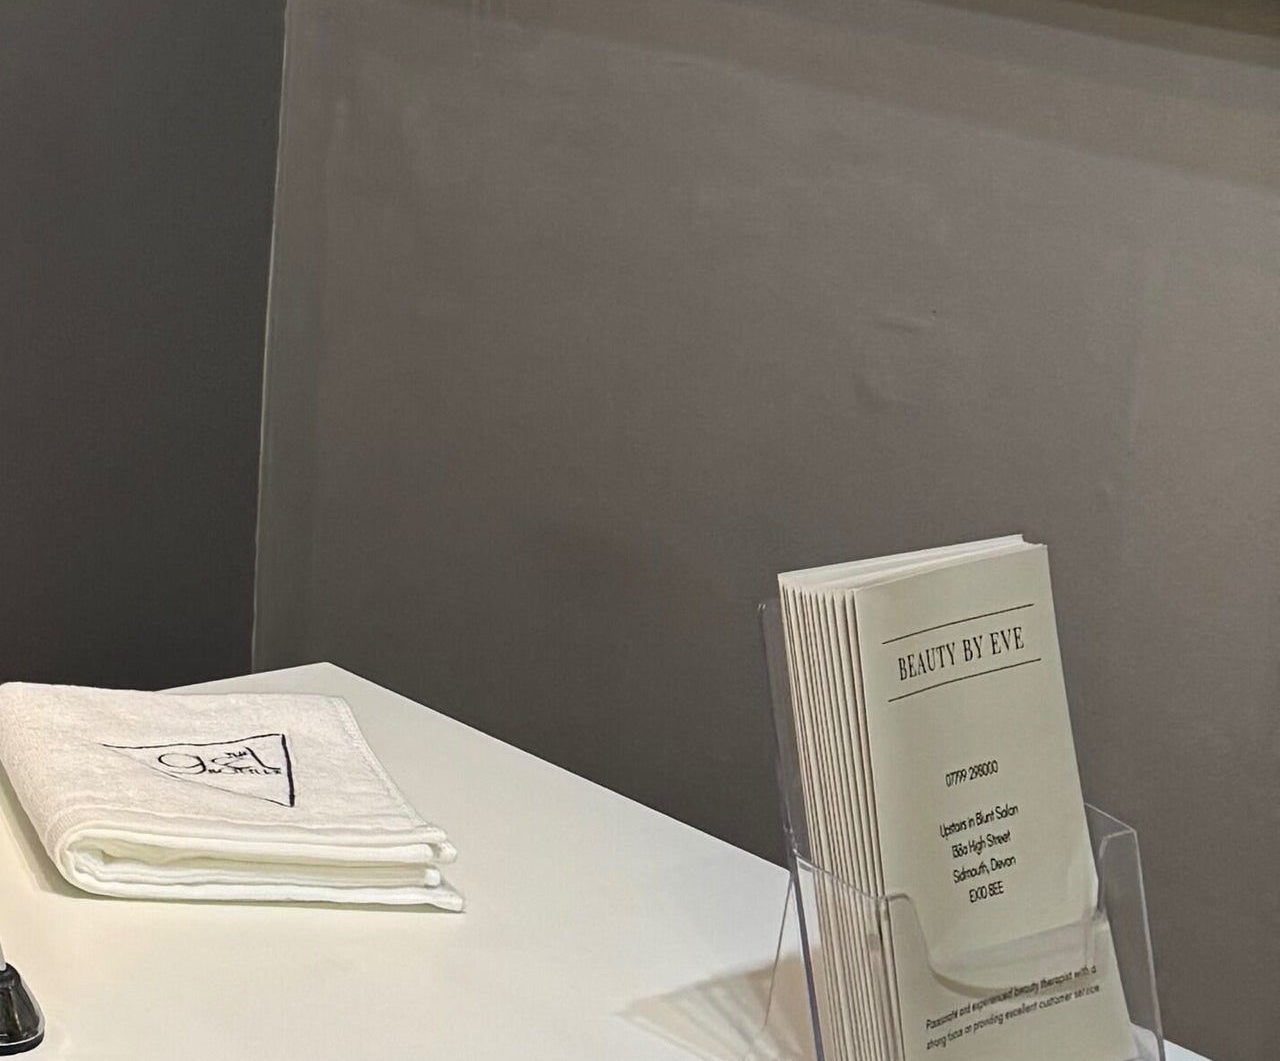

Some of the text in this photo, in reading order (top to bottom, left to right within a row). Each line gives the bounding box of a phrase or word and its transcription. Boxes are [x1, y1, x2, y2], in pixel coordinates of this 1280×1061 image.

[898, 626, 1025, 681] BEAUTY BY EVE
[157, 746, 282, 775] gel
[939, 803, 1019, 841] Upstairs in Blunt Salon
[968, 835, 987, 856] High
[986, 829, 1011, 848] Street
[990, 855, 1017, 873] Devon
